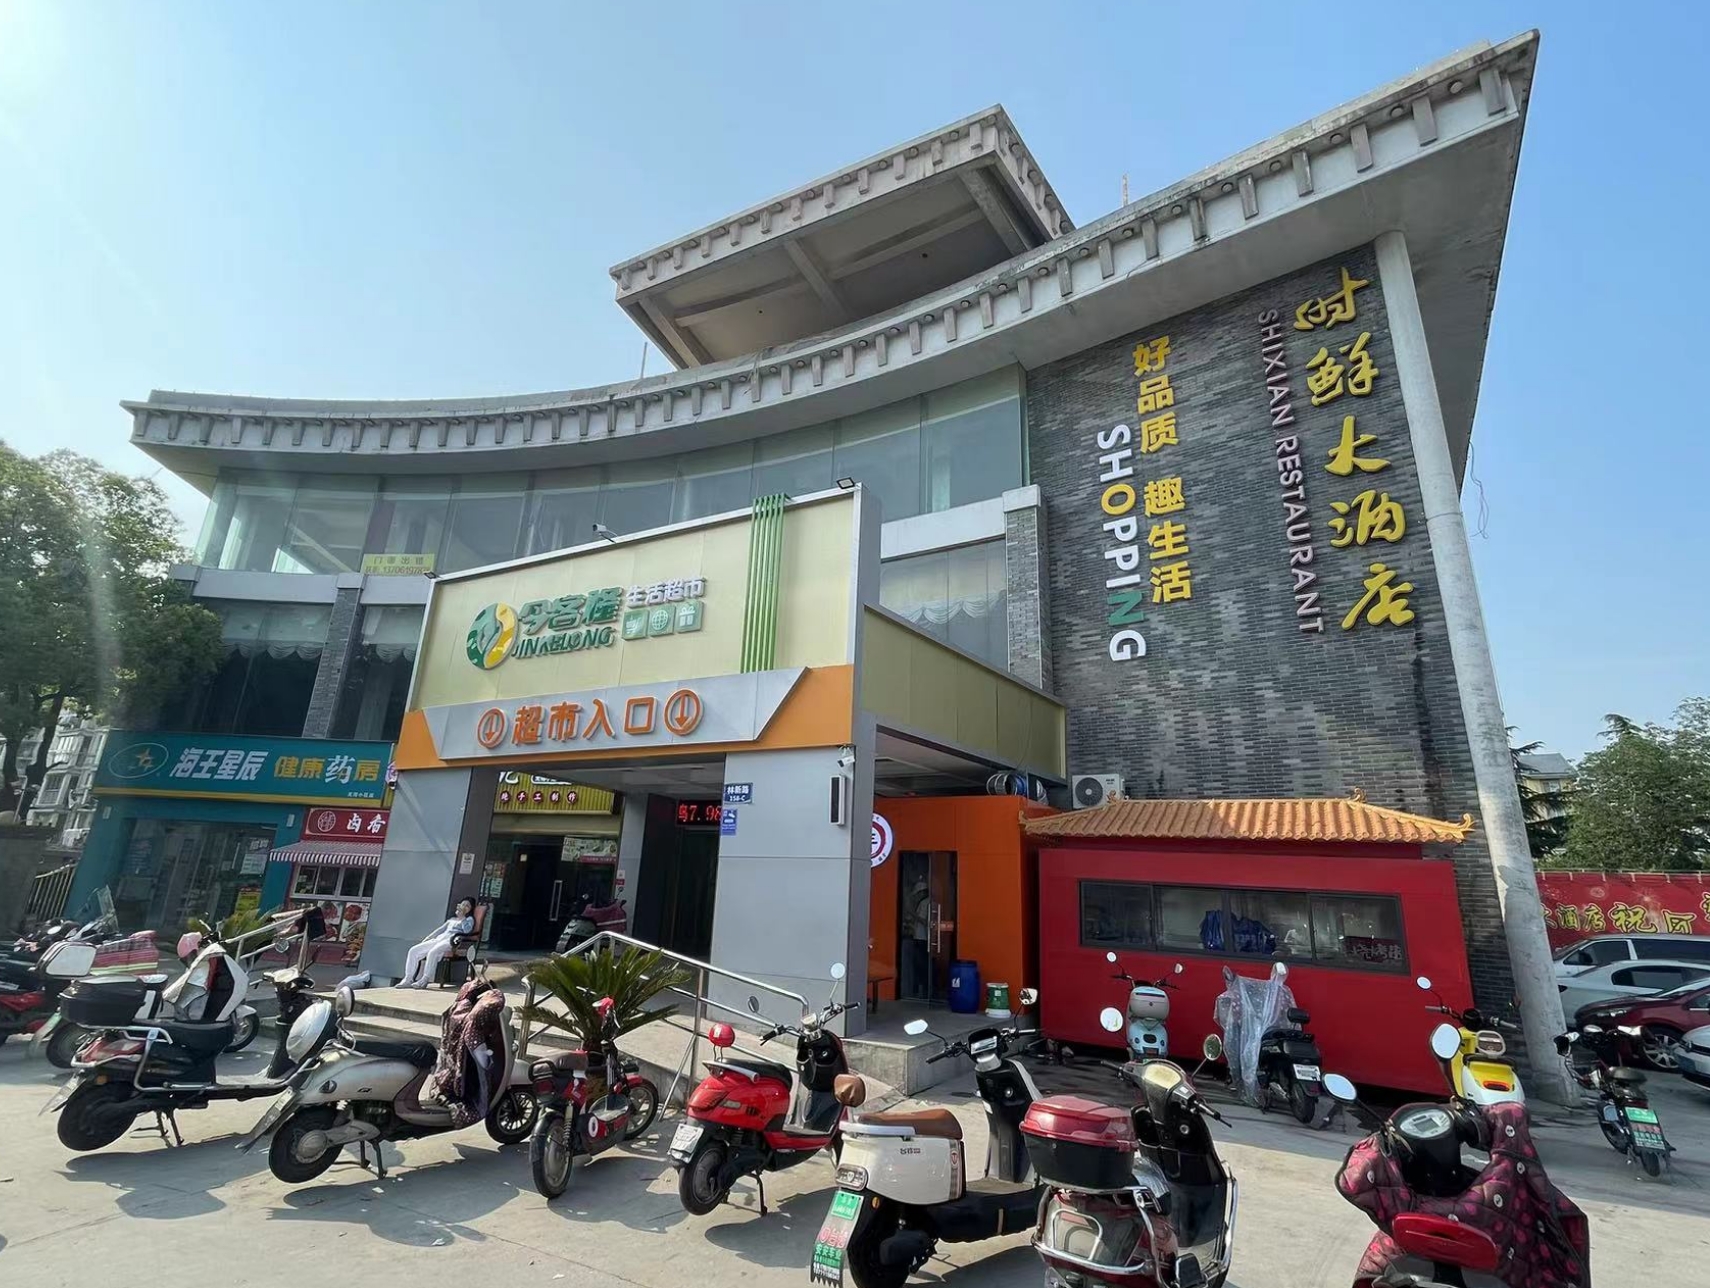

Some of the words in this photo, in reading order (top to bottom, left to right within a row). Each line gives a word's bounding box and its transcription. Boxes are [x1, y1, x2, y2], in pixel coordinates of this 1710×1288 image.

[1257, 308, 1295, 428] SHIXIAN
[1132, 335, 1180, 455] 好品质
[1097, 423, 1147, 662] SHOPPING
[1143, 476, 1192, 604] 趣生活
[1275, 435, 1326, 634] RESTAURANT
[517, 586, 624, 636] 今客隆
[625, 576, 707, 609] 生活超市
[511, 625, 617, 660] JINKELONG
[511, 695, 657, 747] 超市入口
[169, 747, 269, 782] 海王星辰
[273, 754, 382, 785] 健康药房
[347, 812, 386, 834] 卤香
